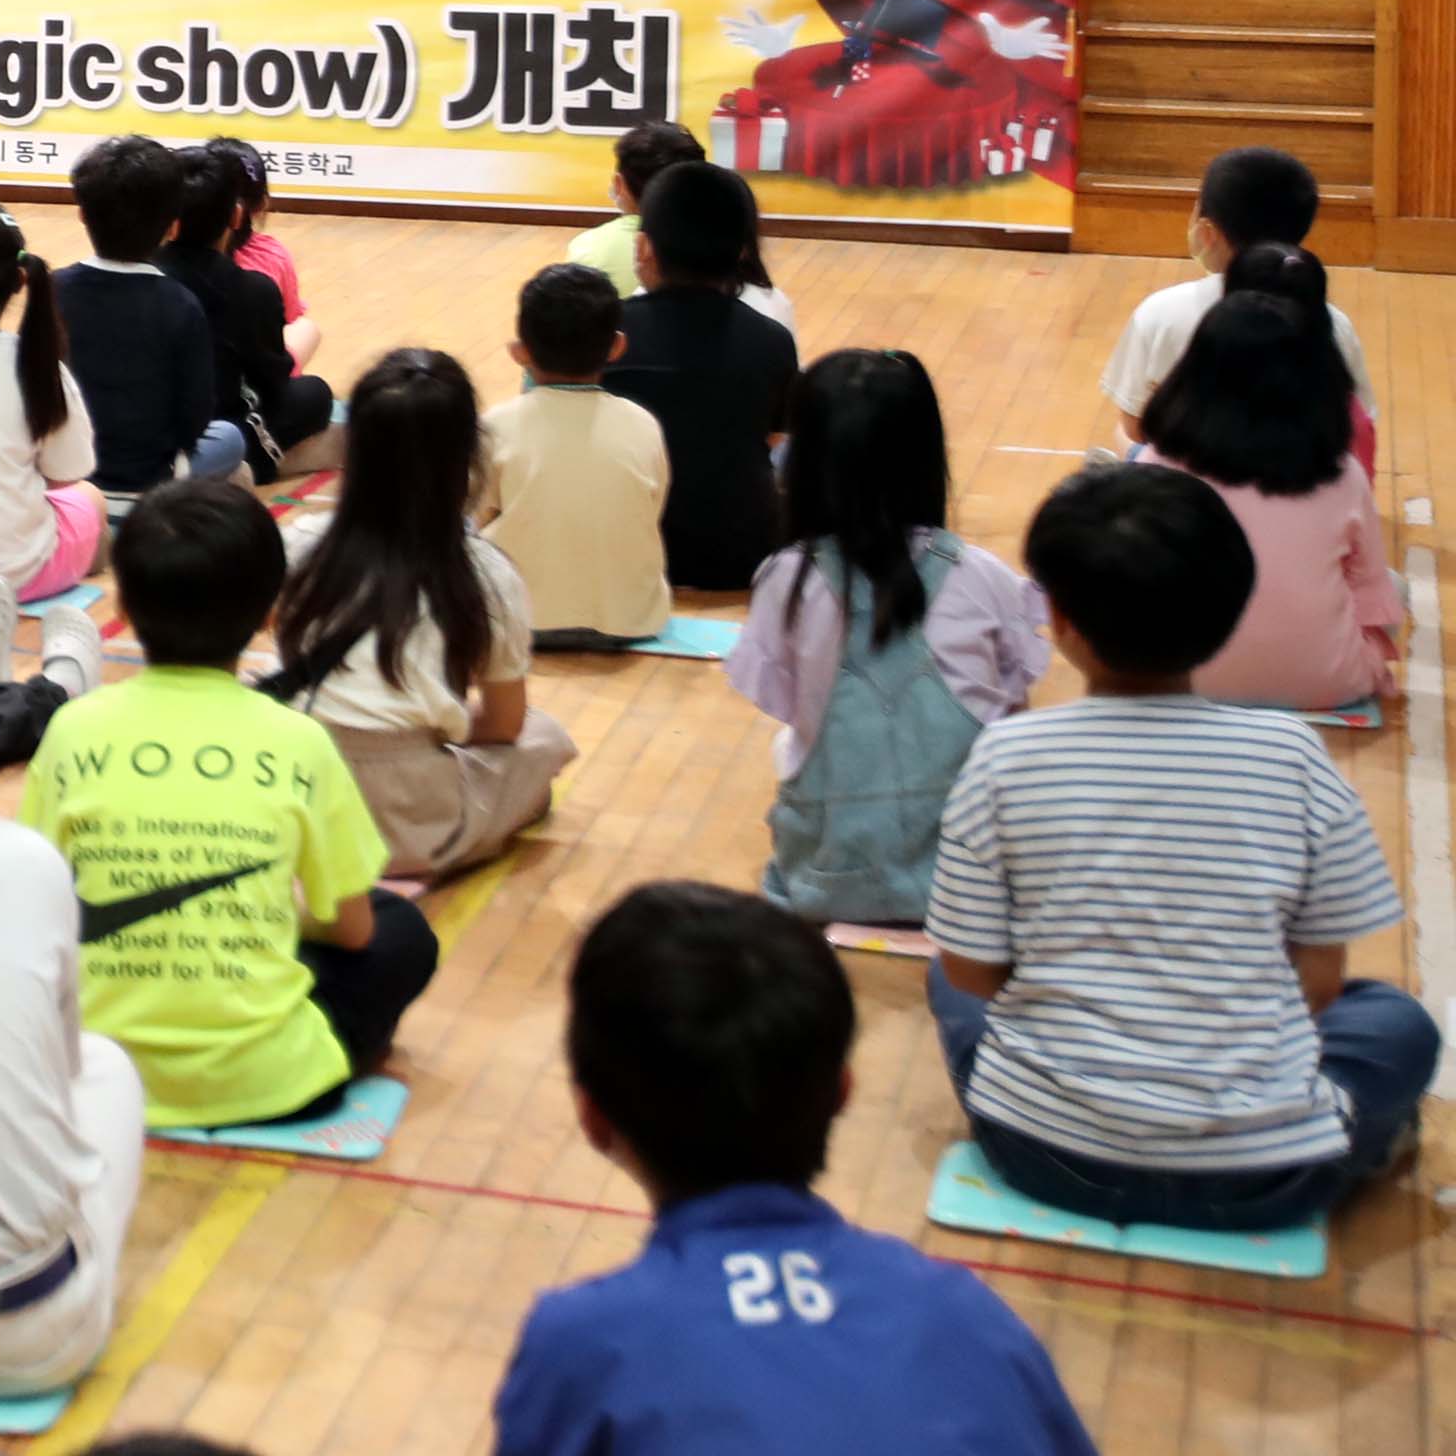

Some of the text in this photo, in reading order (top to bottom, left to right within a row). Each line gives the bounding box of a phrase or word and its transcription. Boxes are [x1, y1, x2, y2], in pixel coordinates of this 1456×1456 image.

[136, 25, 408, 121] show)
[448, 7, 669, 127] 개최
[15, 141, 59, 164] 동구
[54, 741, 315, 805] SWOOSH
[136, 817, 277, 844] International
[170, 845, 193, 863] of
[722, 1250, 835, 1326] 26
